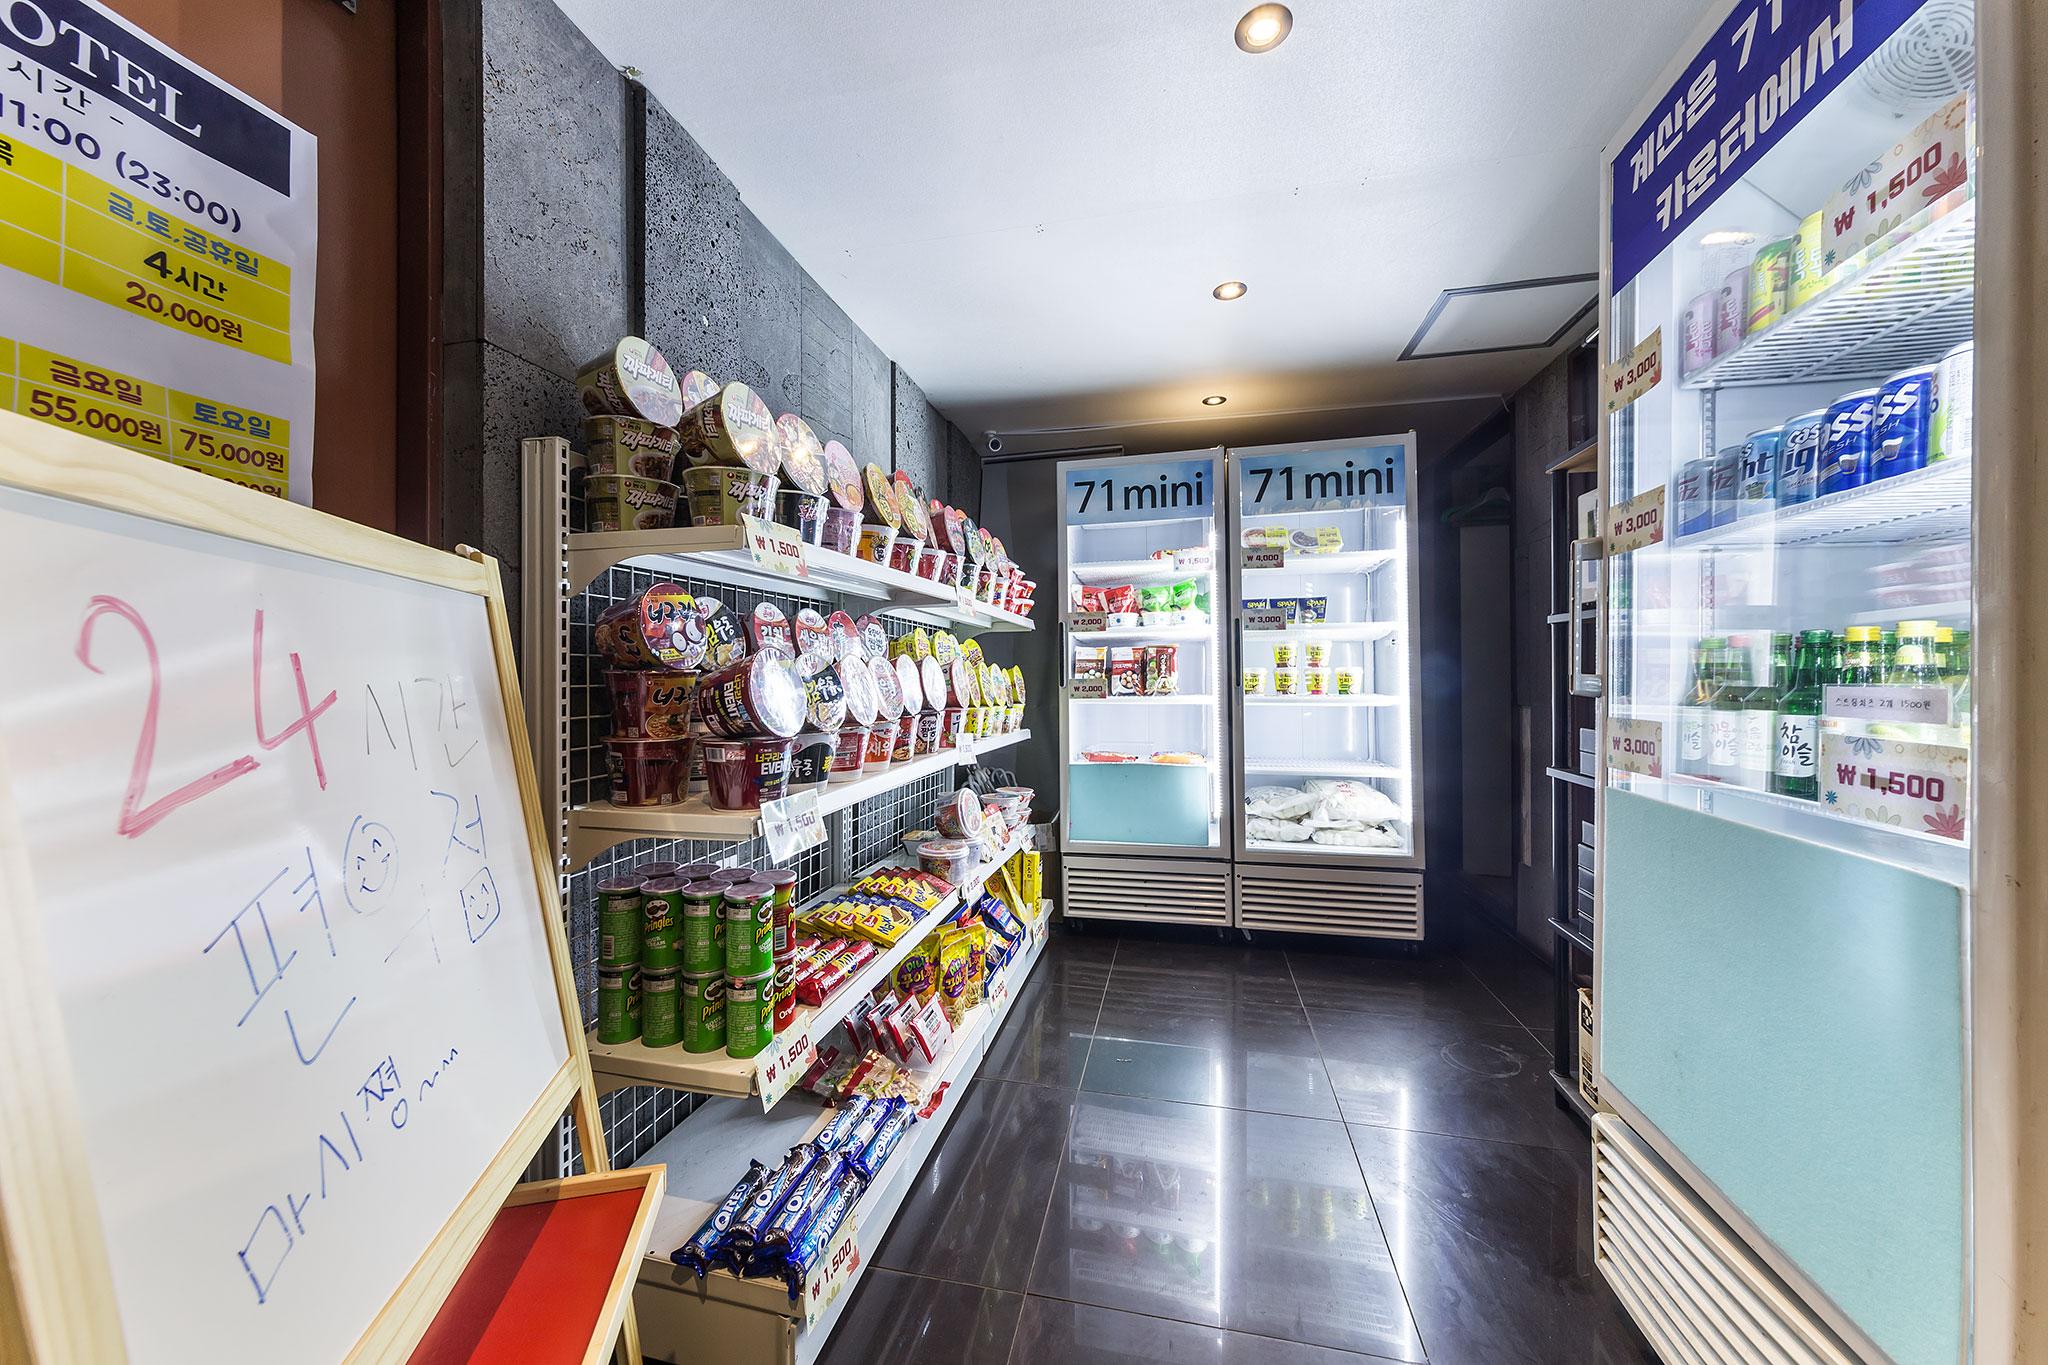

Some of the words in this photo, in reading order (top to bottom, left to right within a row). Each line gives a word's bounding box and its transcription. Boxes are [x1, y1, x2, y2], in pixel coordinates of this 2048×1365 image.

[8, 60, 92, 117] 시간
[1630, 58, 1717, 193] 계산은
[1655, 0, 1854, 233] 카운터에서
[115, 150, 243, 234] (23:00)
[1865, 141, 1942, 216] 1,500
[107, 192, 259, 277] 금,토,공휴일
[143, 251, 228, 302] 4시간
[125, 281, 243, 344] 20,000원
[50, 360, 142, 406] 금요일
[622, 353, 676, 392] 짜파게티
[1627, 350, 1657, 387] 3,000
[29, 389, 162, 445] 55,000원
[193, 402, 271, 439] 토요일
[179, 428, 285, 473] 75,000원
[1625, 508, 1658, 534] 3,000
[769, 538, 801, 559] 1,500
[1188, 557, 1210, 566] 1,500
[1255, 553, 1280, 563] 4,000
[1247, 601, 1266, 610] SPAM
[1257, 616, 1281, 624] 3,000
[1276, 600, 1297, 609] SPAM
[1306, 599, 1327, 608] SPAM
[1081, 618, 1103, 627] 2,000
[723, 681, 741, 722] EVENT
[1081, 685, 1103, 693] 2,000
[1901, 698, 1932, 710] 1500원
[75, 595, 338, 838] 24
[366, 674, 479, 771] 시간
[1780, 722, 1803, 744] 참
[866, 741, 890, 757] 새우
[1624, 736, 1657, 757] 3,000
[1782, 742, 1815, 767] 이슬
[1865, 767, 1945, 803] 1,500
[788, 811, 816, 833] 1,500
[779, 1033, 809, 1069] 1,500
[713, 1183, 749, 1233] OREO
[823, 1237, 852, 1284] 1,500
